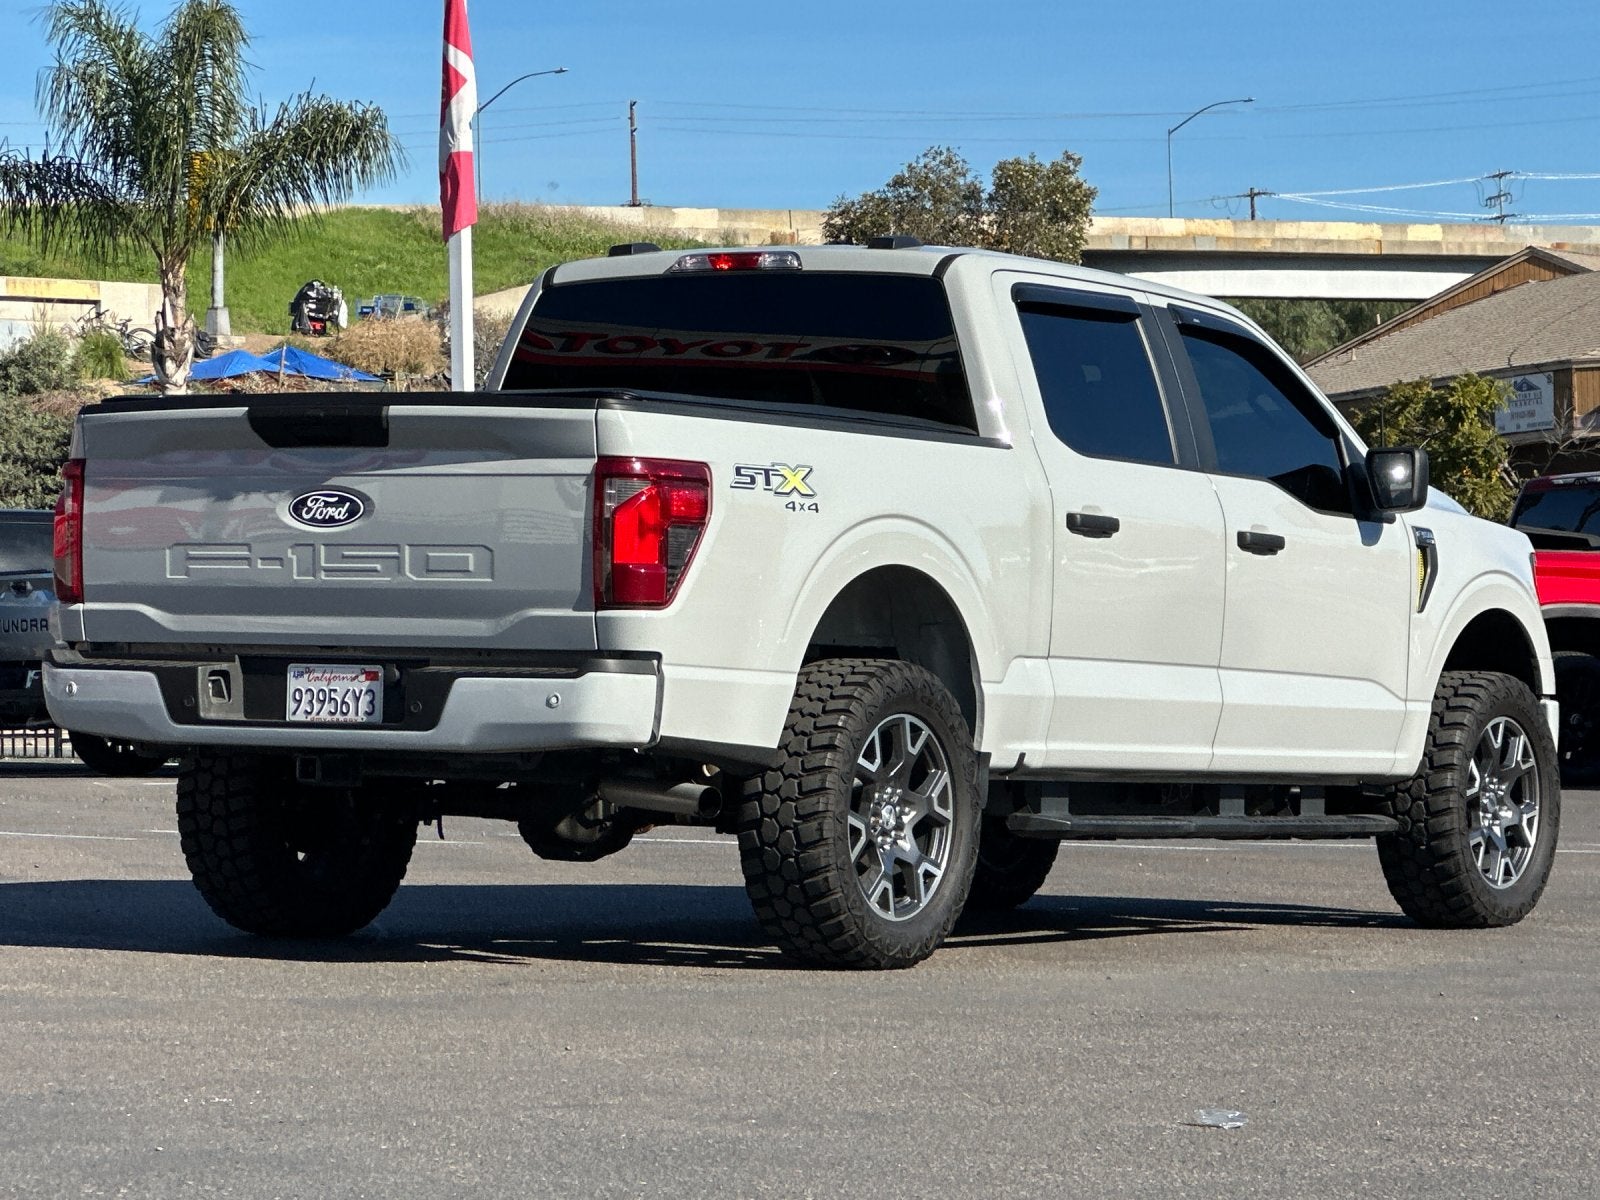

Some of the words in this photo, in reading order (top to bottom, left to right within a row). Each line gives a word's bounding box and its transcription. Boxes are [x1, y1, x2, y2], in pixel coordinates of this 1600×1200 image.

[730, 462, 817, 498] STX
[302, 495, 351, 519] Ford
[165, 542, 495, 582] F-150
[0, 618, 48, 632] UNDRA
[291, 688, 376, 717] 93956Y3
